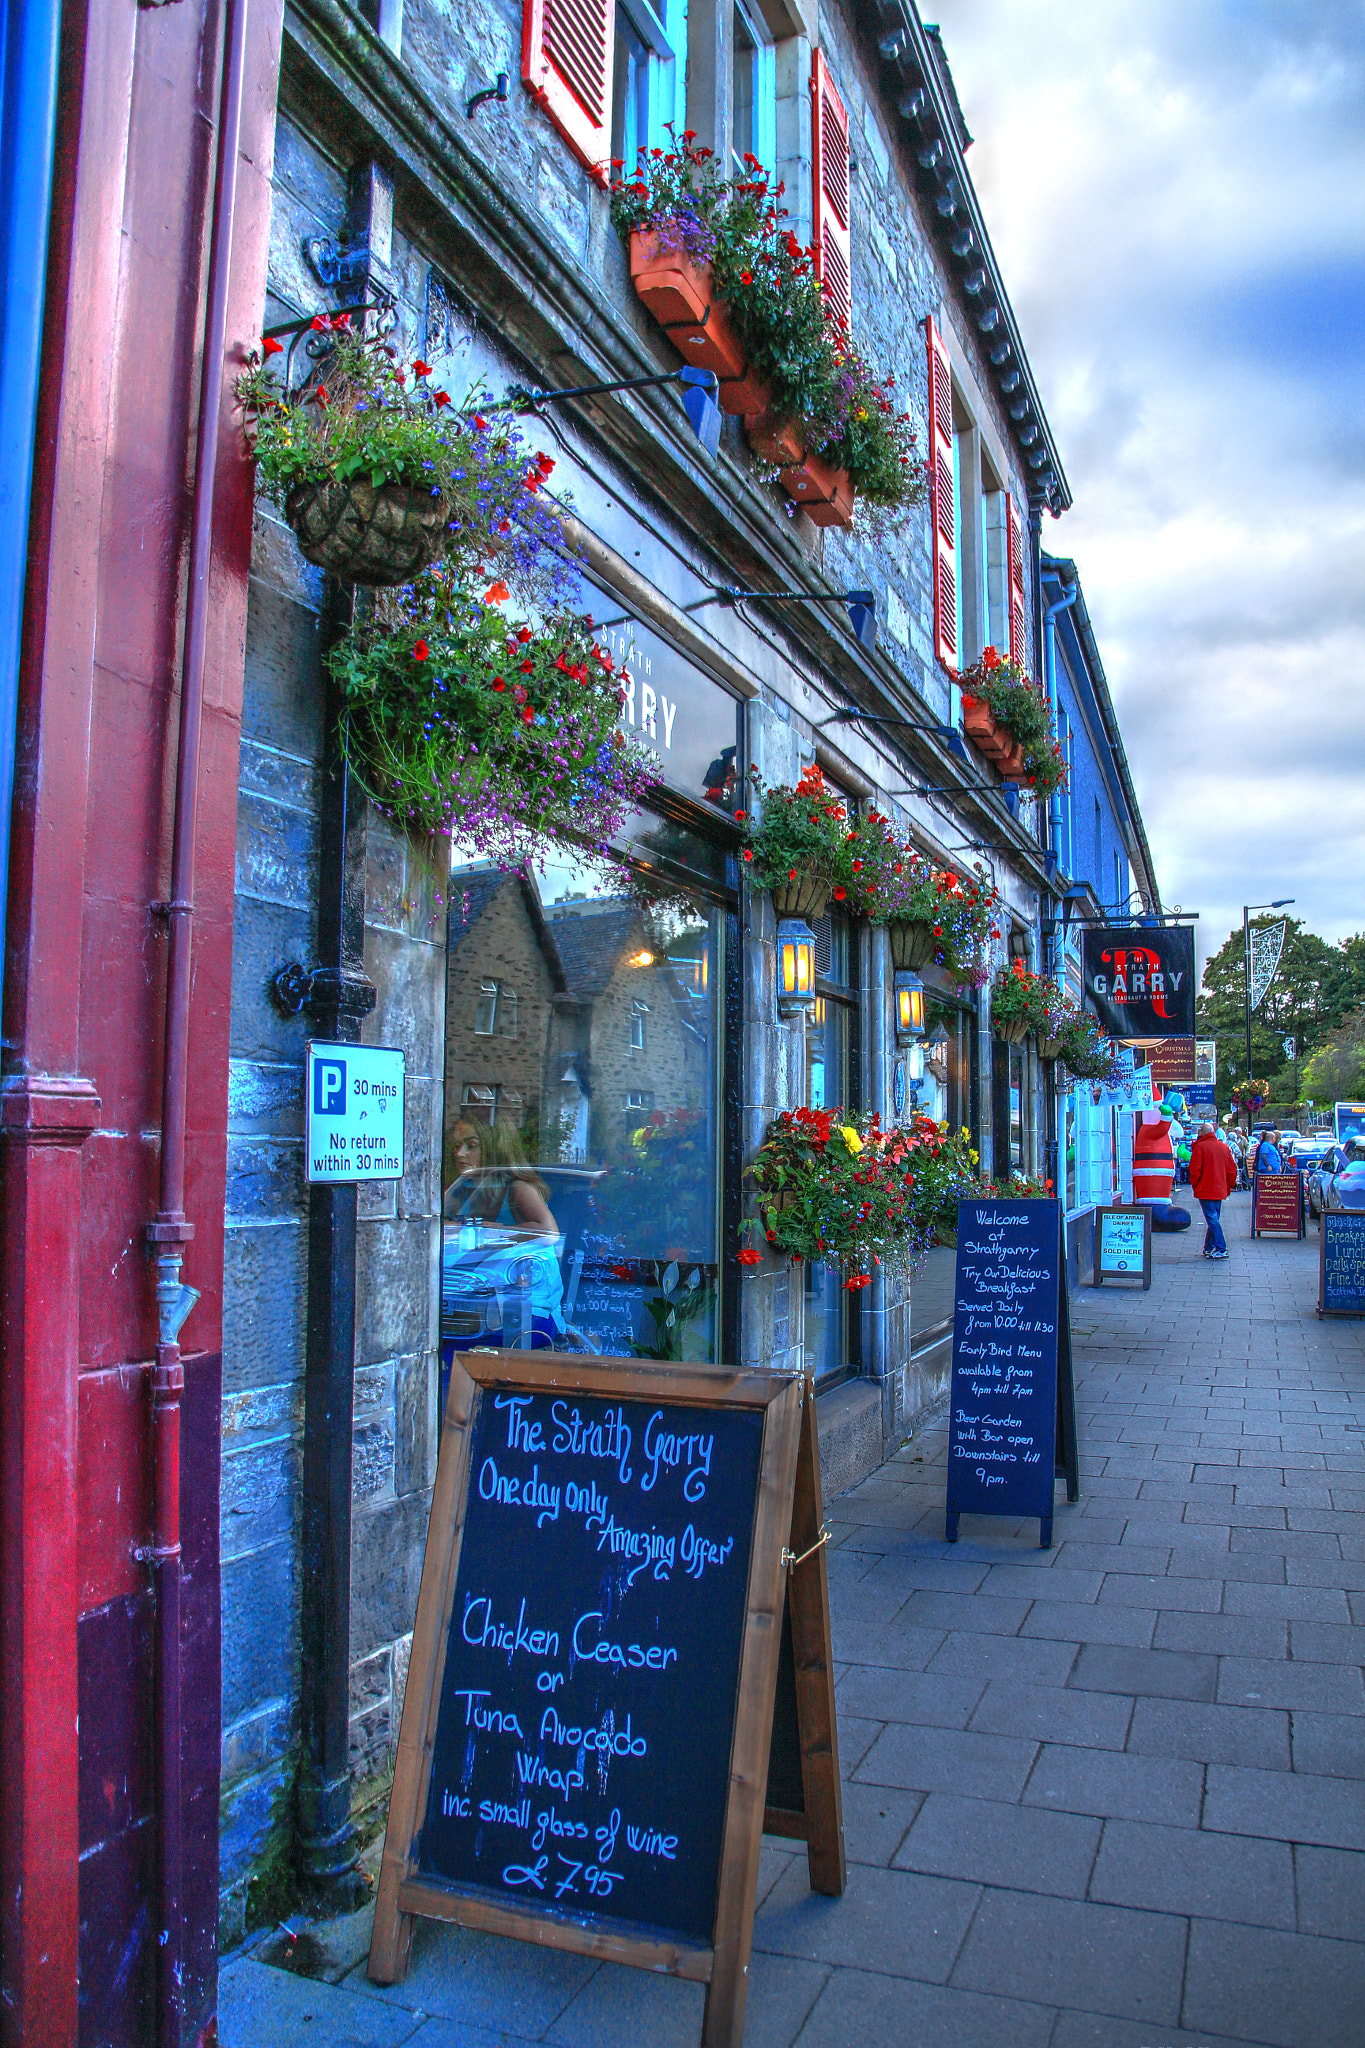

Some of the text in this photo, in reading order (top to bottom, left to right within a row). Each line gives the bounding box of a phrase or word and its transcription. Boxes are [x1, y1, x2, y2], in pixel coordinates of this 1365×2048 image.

[623, 619, 634, 638] THE
[601, 624, 652, 676] STRATH
[619, 666, 677, 750] RRY
[1116, 963, 1159, 971] STRATH
[1093, 972, 1184, 994] GARRY
[1155, 1045, 1191, 1054] CHRISTMAS
[321, 1065, 342, 1110] P
[353, 1079, 397, 1097] 30 mins
[330, 1133, 386, 1149] No return
[314, 1154, 399, 1171] within 30 mins
[975, 1210, 1030, 1225] Welcome
[988, 1228, 1006, 1241] at
[1336, 1244, 1365, 1258] Lunch
[961, 1265, 1050, 1284] Try Our Delicious
[1325, 1258, 1349, 1273] Daily
[1328, 1272, 1351, 1285] Fine
[975, 1281, 1036, 1300] Breakfast
[957, 1300, 1025, 1314] Served Daily
[964, 1315, 1054, 1336] from 10.00 till 11.30
[959, 1341, 1042, 1360] Early Bird Menu
[958, 1364, 1033, 1382] available from
[971, 1381, 1034, 1399] 4pm till 7pm
[955, 1409, 1023, 1428] Beer Garden
[957, 1428, 1034, 1447] with Bar open
[495, 1394, 714, 1503] The Strath Garry
[953, 1445, 1041, 1464] Downstairs till
[479, 1457, 608, 1531] One day only
[597, 1514, 733, 1586] Amazing Offer
[463, 1597, 677, 1670] Chicken Ceaser
[537, 1672, 564, 1692] or
[455, 1690, 647, 1757] Tuna Avocado
[517, 1751, 585, 1801] Wrap
[443, 1789, 679, 1863] inc. small glass of wine
